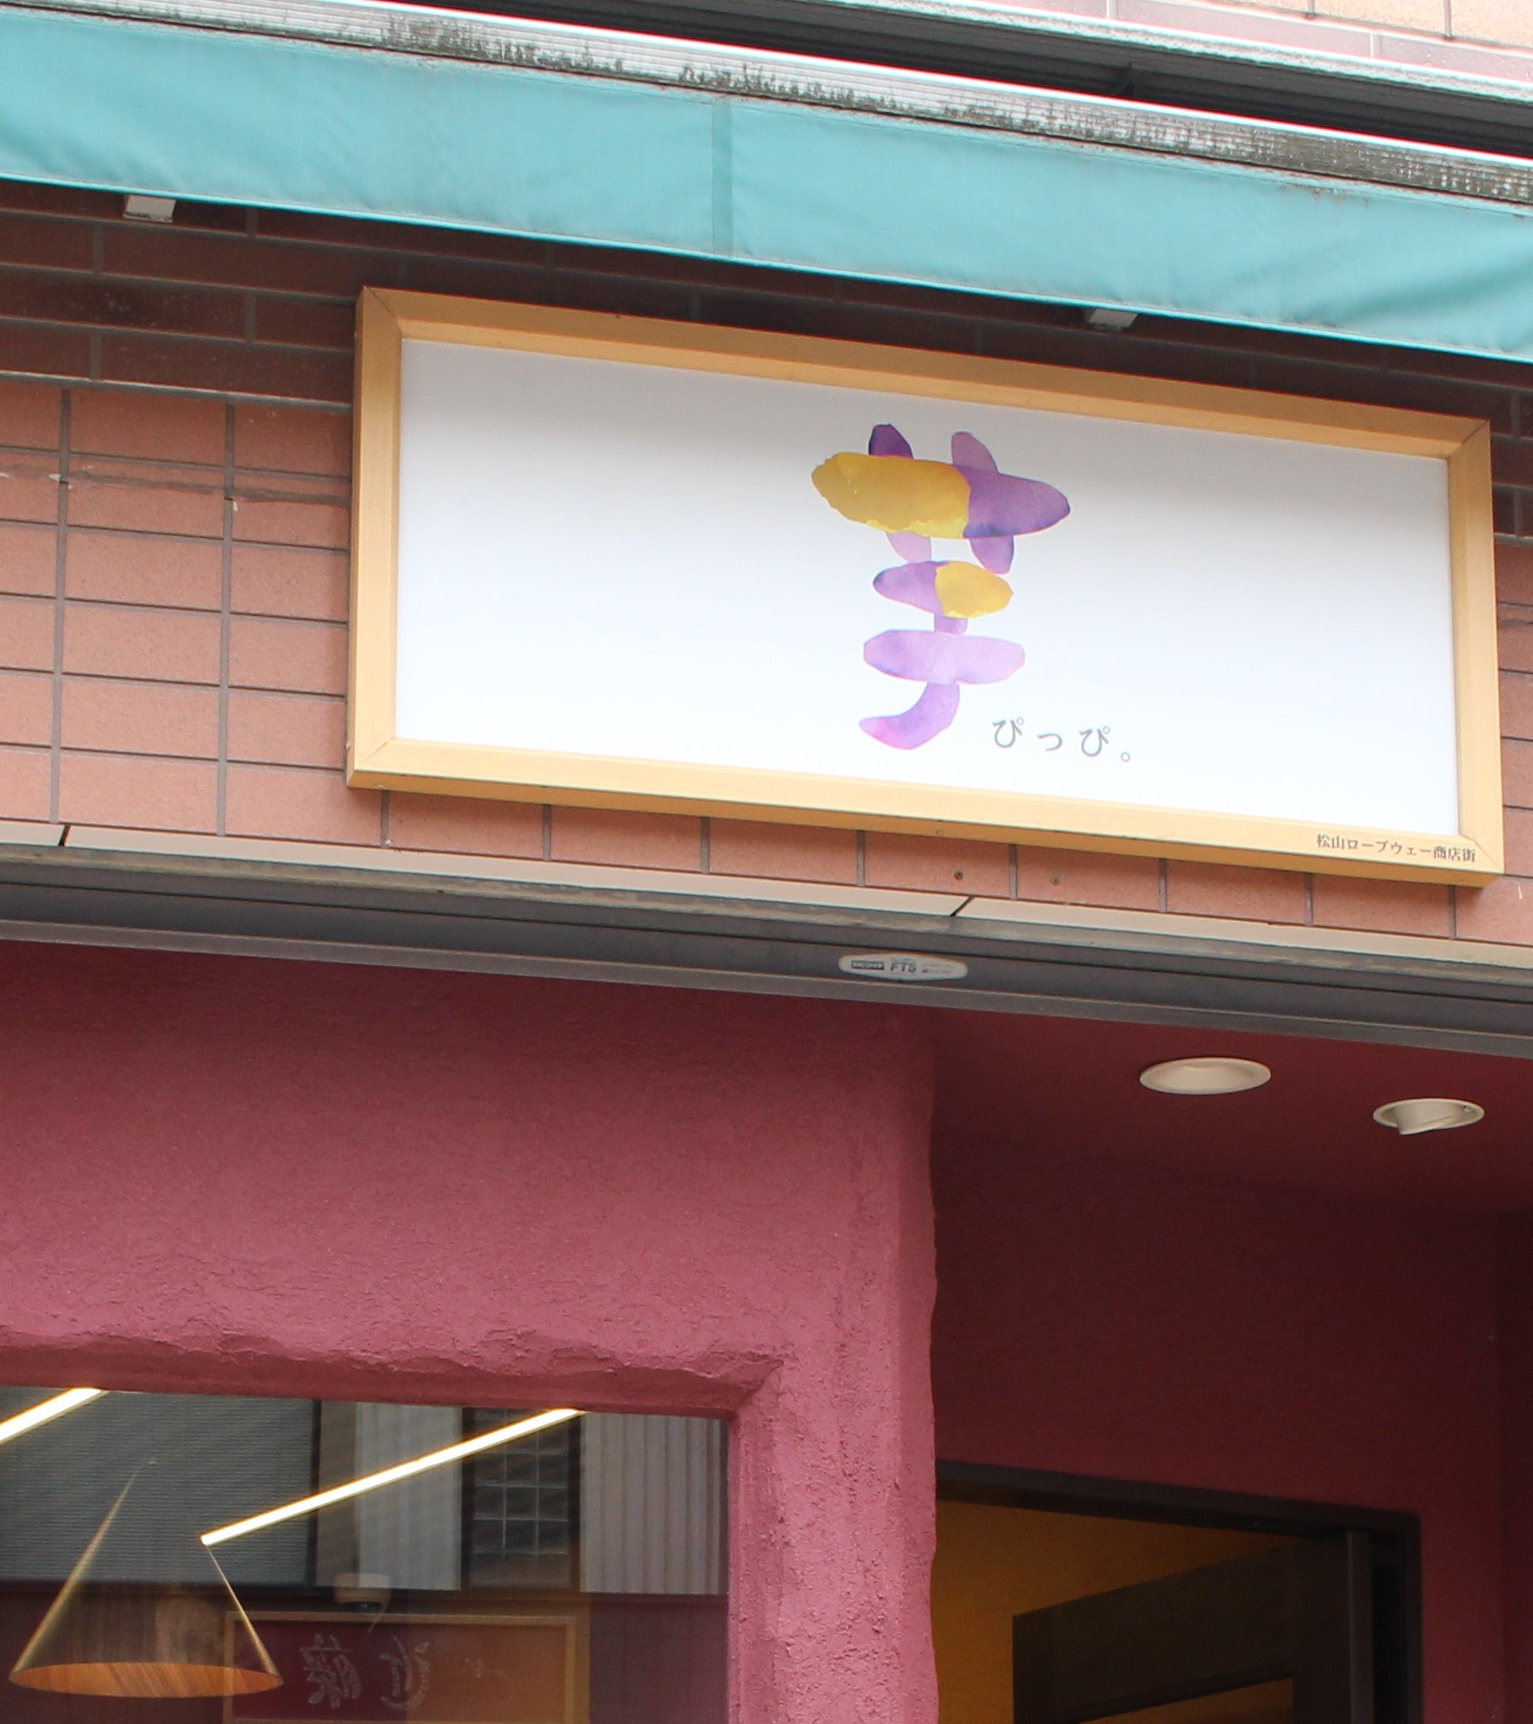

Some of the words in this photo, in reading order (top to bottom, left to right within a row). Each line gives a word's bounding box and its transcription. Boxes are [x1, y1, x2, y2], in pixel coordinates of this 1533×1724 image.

[991, 716, 1132, 762] ぴっぴ。
[1316, 832, 1477, 864] 松山ロープウェー商店街
